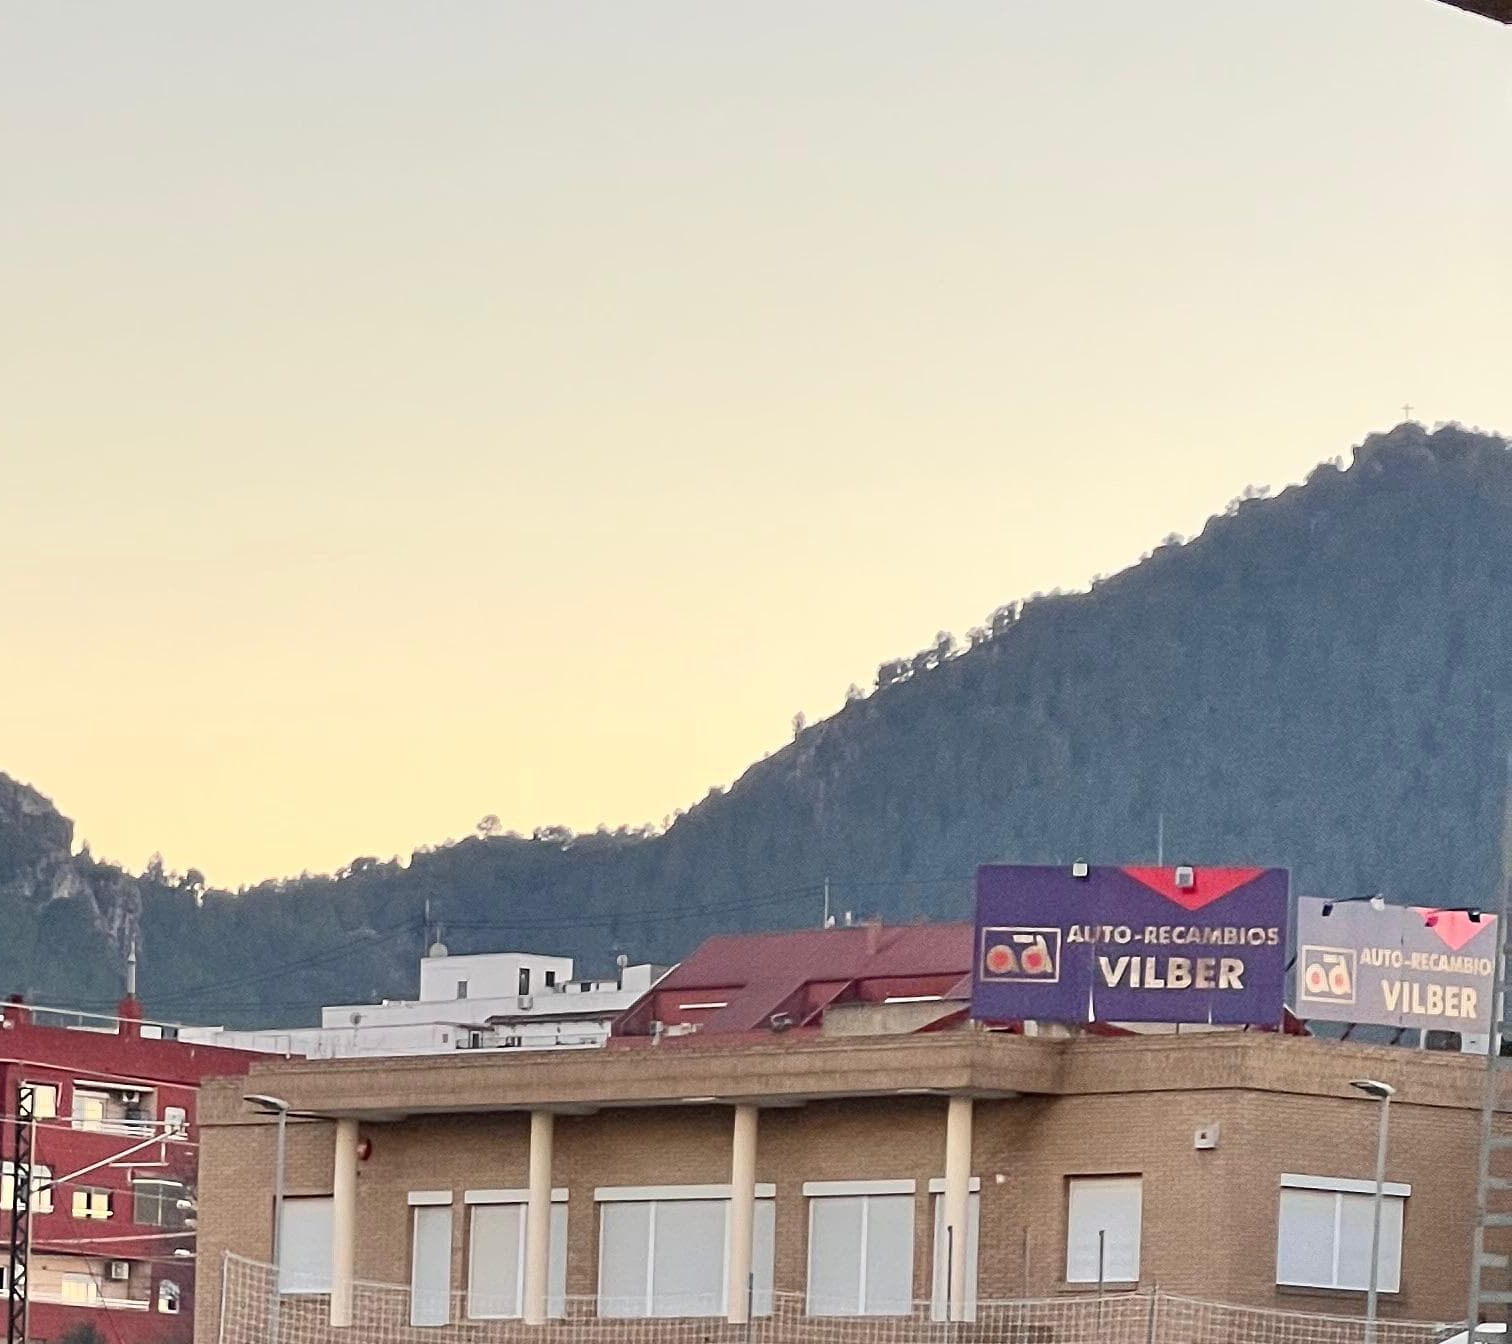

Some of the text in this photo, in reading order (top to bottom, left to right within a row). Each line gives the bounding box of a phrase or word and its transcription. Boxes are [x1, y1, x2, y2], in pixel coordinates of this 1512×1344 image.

[1066, 924, 1280, 946] AUTO-RECAMBIOS
[1098, 955, 1245, 990] VILBER
[1359, 947, 1495, 977] AUTO-RECAMBIO
[1381, 979, 1478, 1019] VILBER
